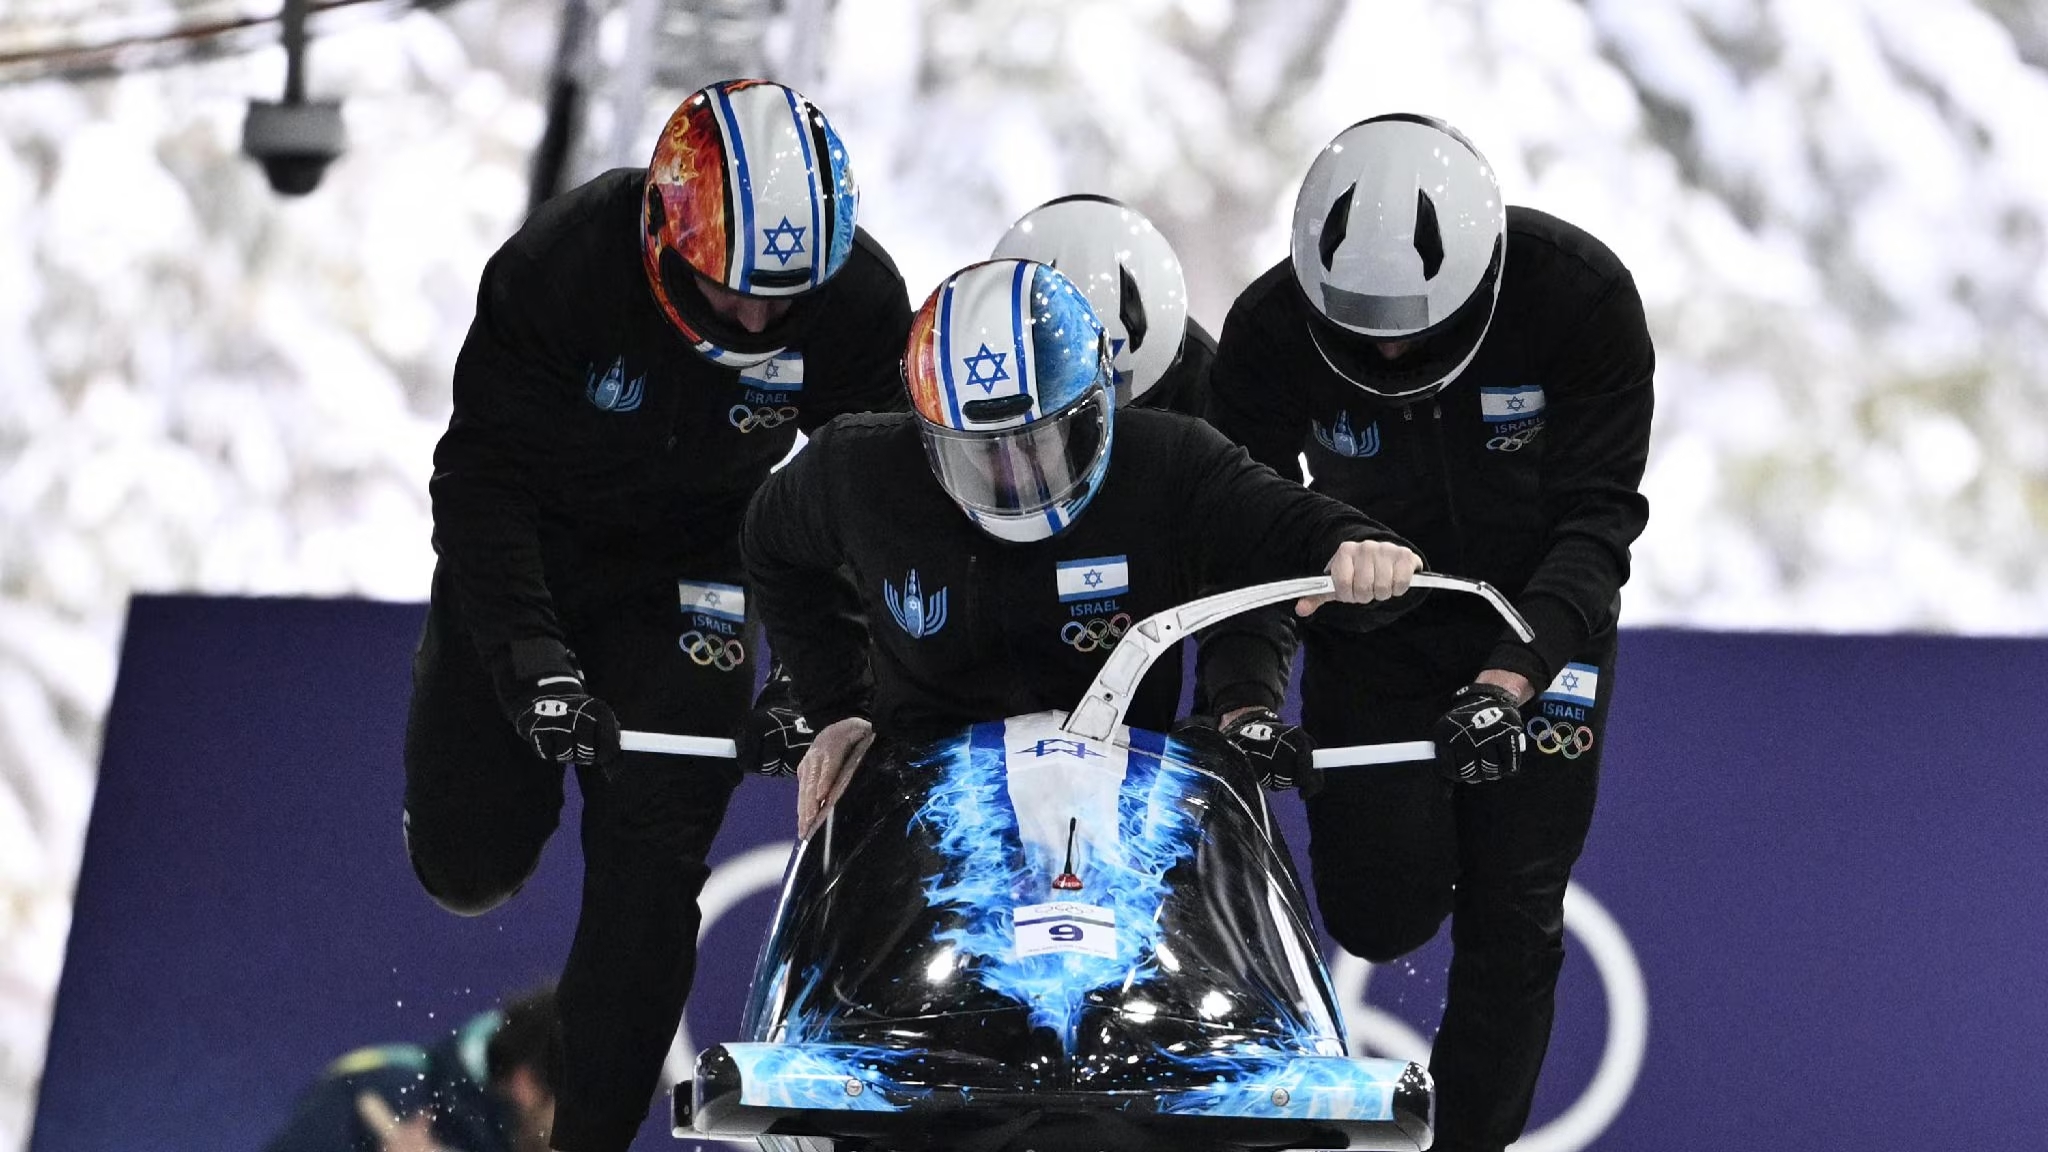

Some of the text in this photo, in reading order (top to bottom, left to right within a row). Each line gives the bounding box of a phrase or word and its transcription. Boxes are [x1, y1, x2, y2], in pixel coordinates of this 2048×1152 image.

[744, 389, 789, 404] ISRAEL
[1495, 417, 1540, 433] ISRAEL
[1071, 600, 1119, 616] ISRAEL
[692, 615, 736, 635] ISRAEL
[1049, 924, 1083, 941] 9
